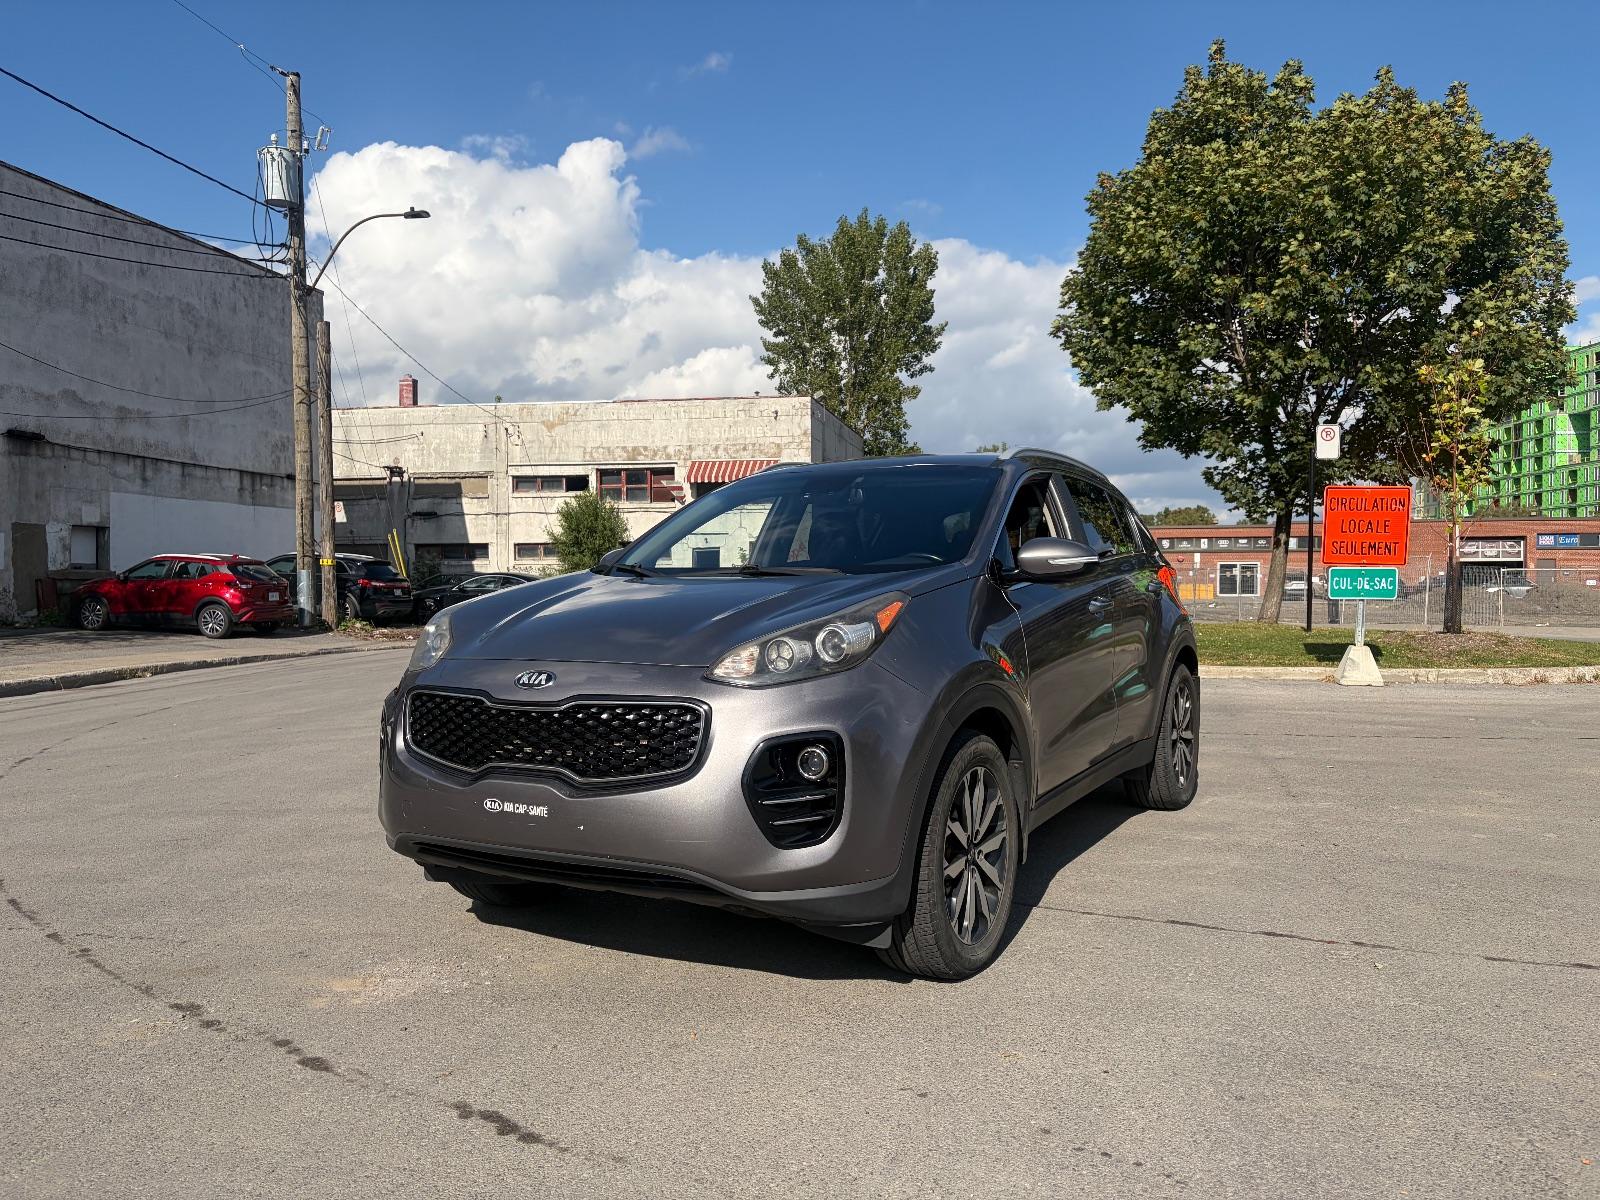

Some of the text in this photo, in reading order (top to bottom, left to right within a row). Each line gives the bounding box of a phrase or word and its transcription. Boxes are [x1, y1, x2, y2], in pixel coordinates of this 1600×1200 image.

[1329, 497, 1406, 512] CIRCULATION
[1340, 518, 1391, 534] LOCALE
[1331, 540, 1400, 556] SEULEMENT
[1332, 577, 1394, 591] CUL-DE-SAC
[485, 800, 548, 818] KIA KIA CAP-SANTÉ
